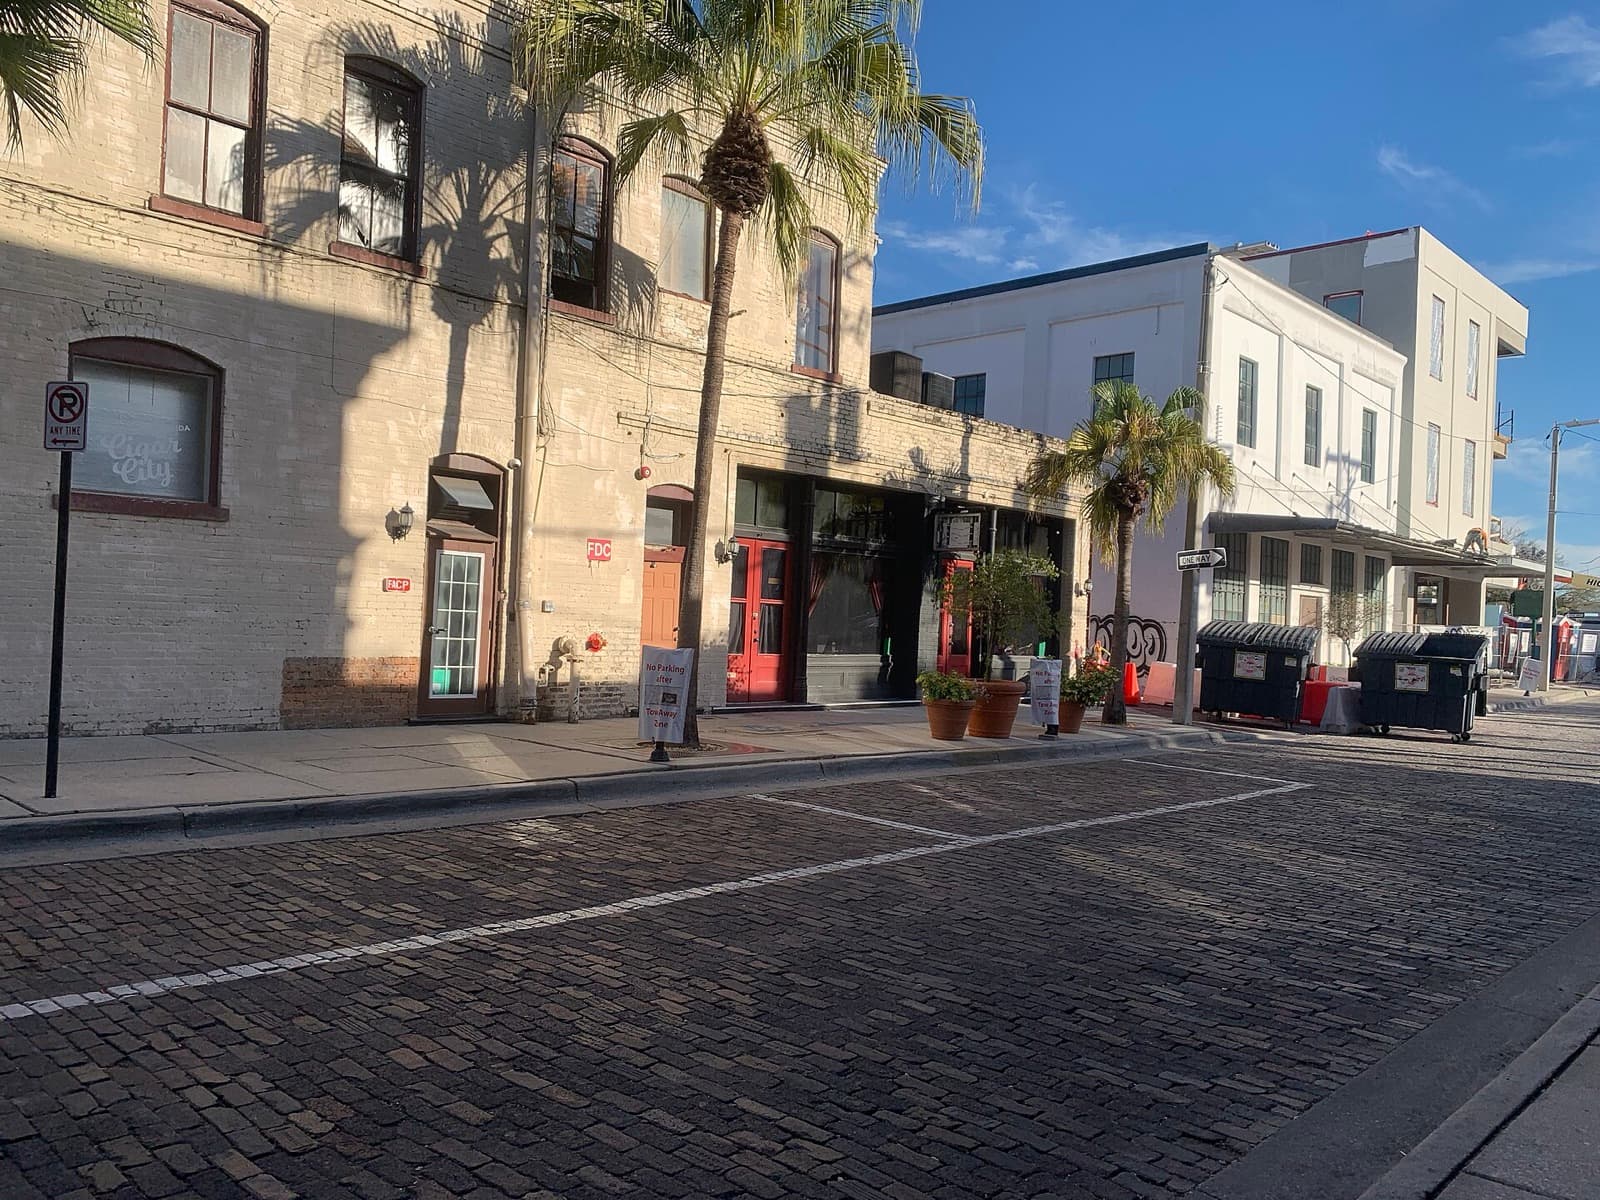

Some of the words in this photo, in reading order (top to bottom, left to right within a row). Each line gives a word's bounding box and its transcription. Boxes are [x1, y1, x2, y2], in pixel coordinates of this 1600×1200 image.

[50, 426, 63, 435] ANY
[65, 426, 80, 436] TIME
[102, 432, 182, 460] Cigar
[112, 457, 174, 487] City
[588, 542, 611, 557] FDC
[1182, 556, 1195, 565] ONE
[1195, 554, 1210, 563] WAY
[387, 579, 409, 590] FACP
[646, 663, 656, 671] No
[657, 664, 685, 675] Parking
[656, 675, 672, 684] after
[659, 708, 677, 719] Away
[653, 719, 668, 729] Zne
